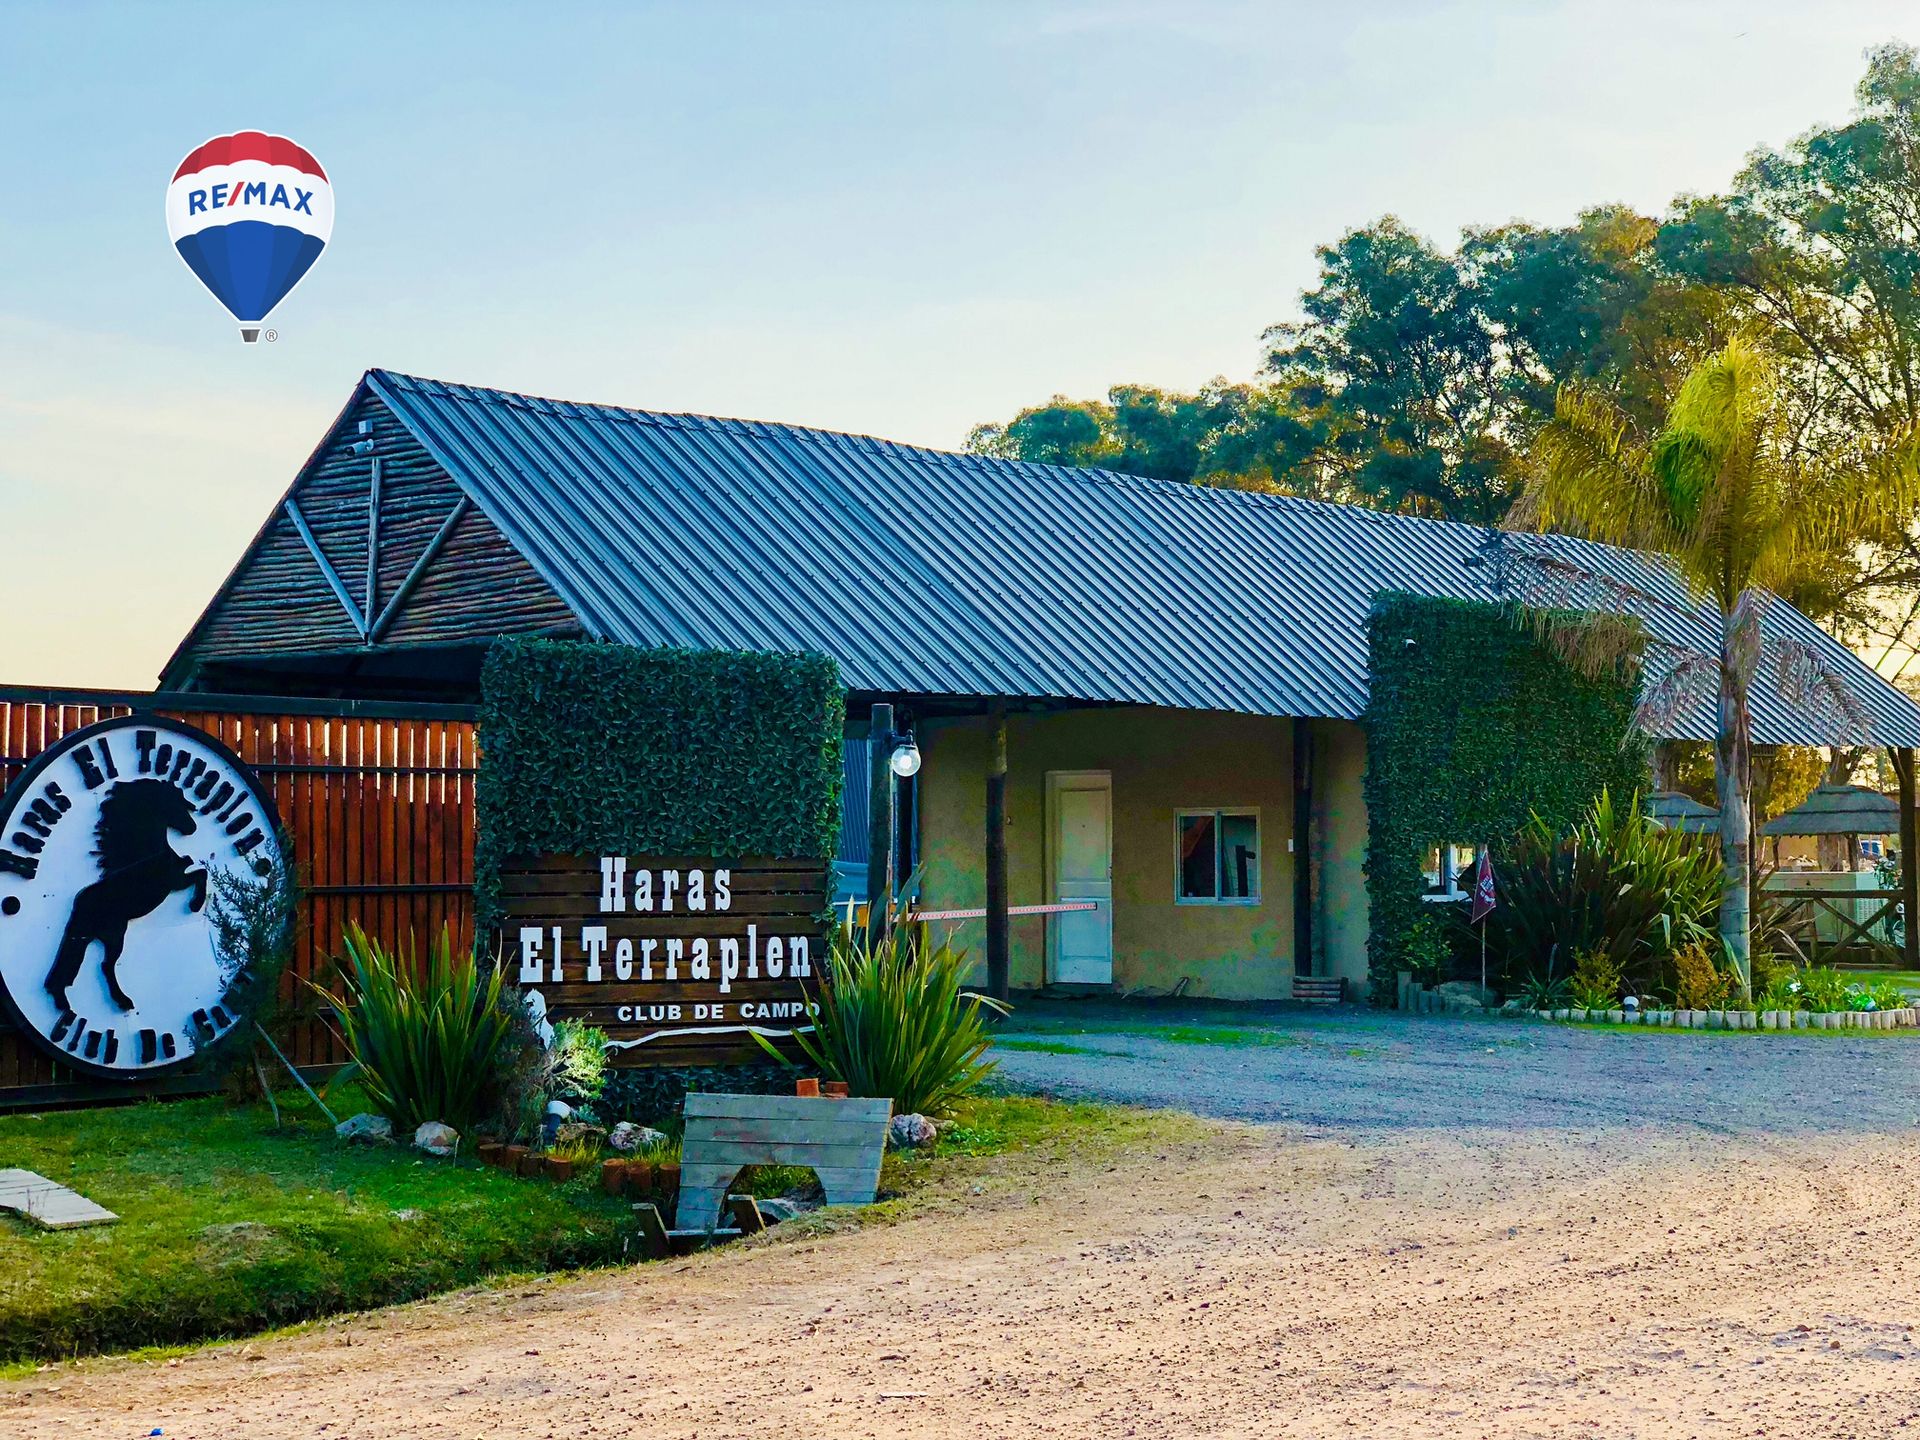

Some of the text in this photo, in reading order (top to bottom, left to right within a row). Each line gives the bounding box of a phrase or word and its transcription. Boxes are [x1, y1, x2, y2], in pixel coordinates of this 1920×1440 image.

[0, 730, 265, 880] Haras El Terraplen
[600, 857, 731, 912] Haras
[520, 924, 811, 993] El Terraplen
[617, 1002, 820, 1022] CLUB DE CAMPO
[139, 1028, 176, 1064] De
